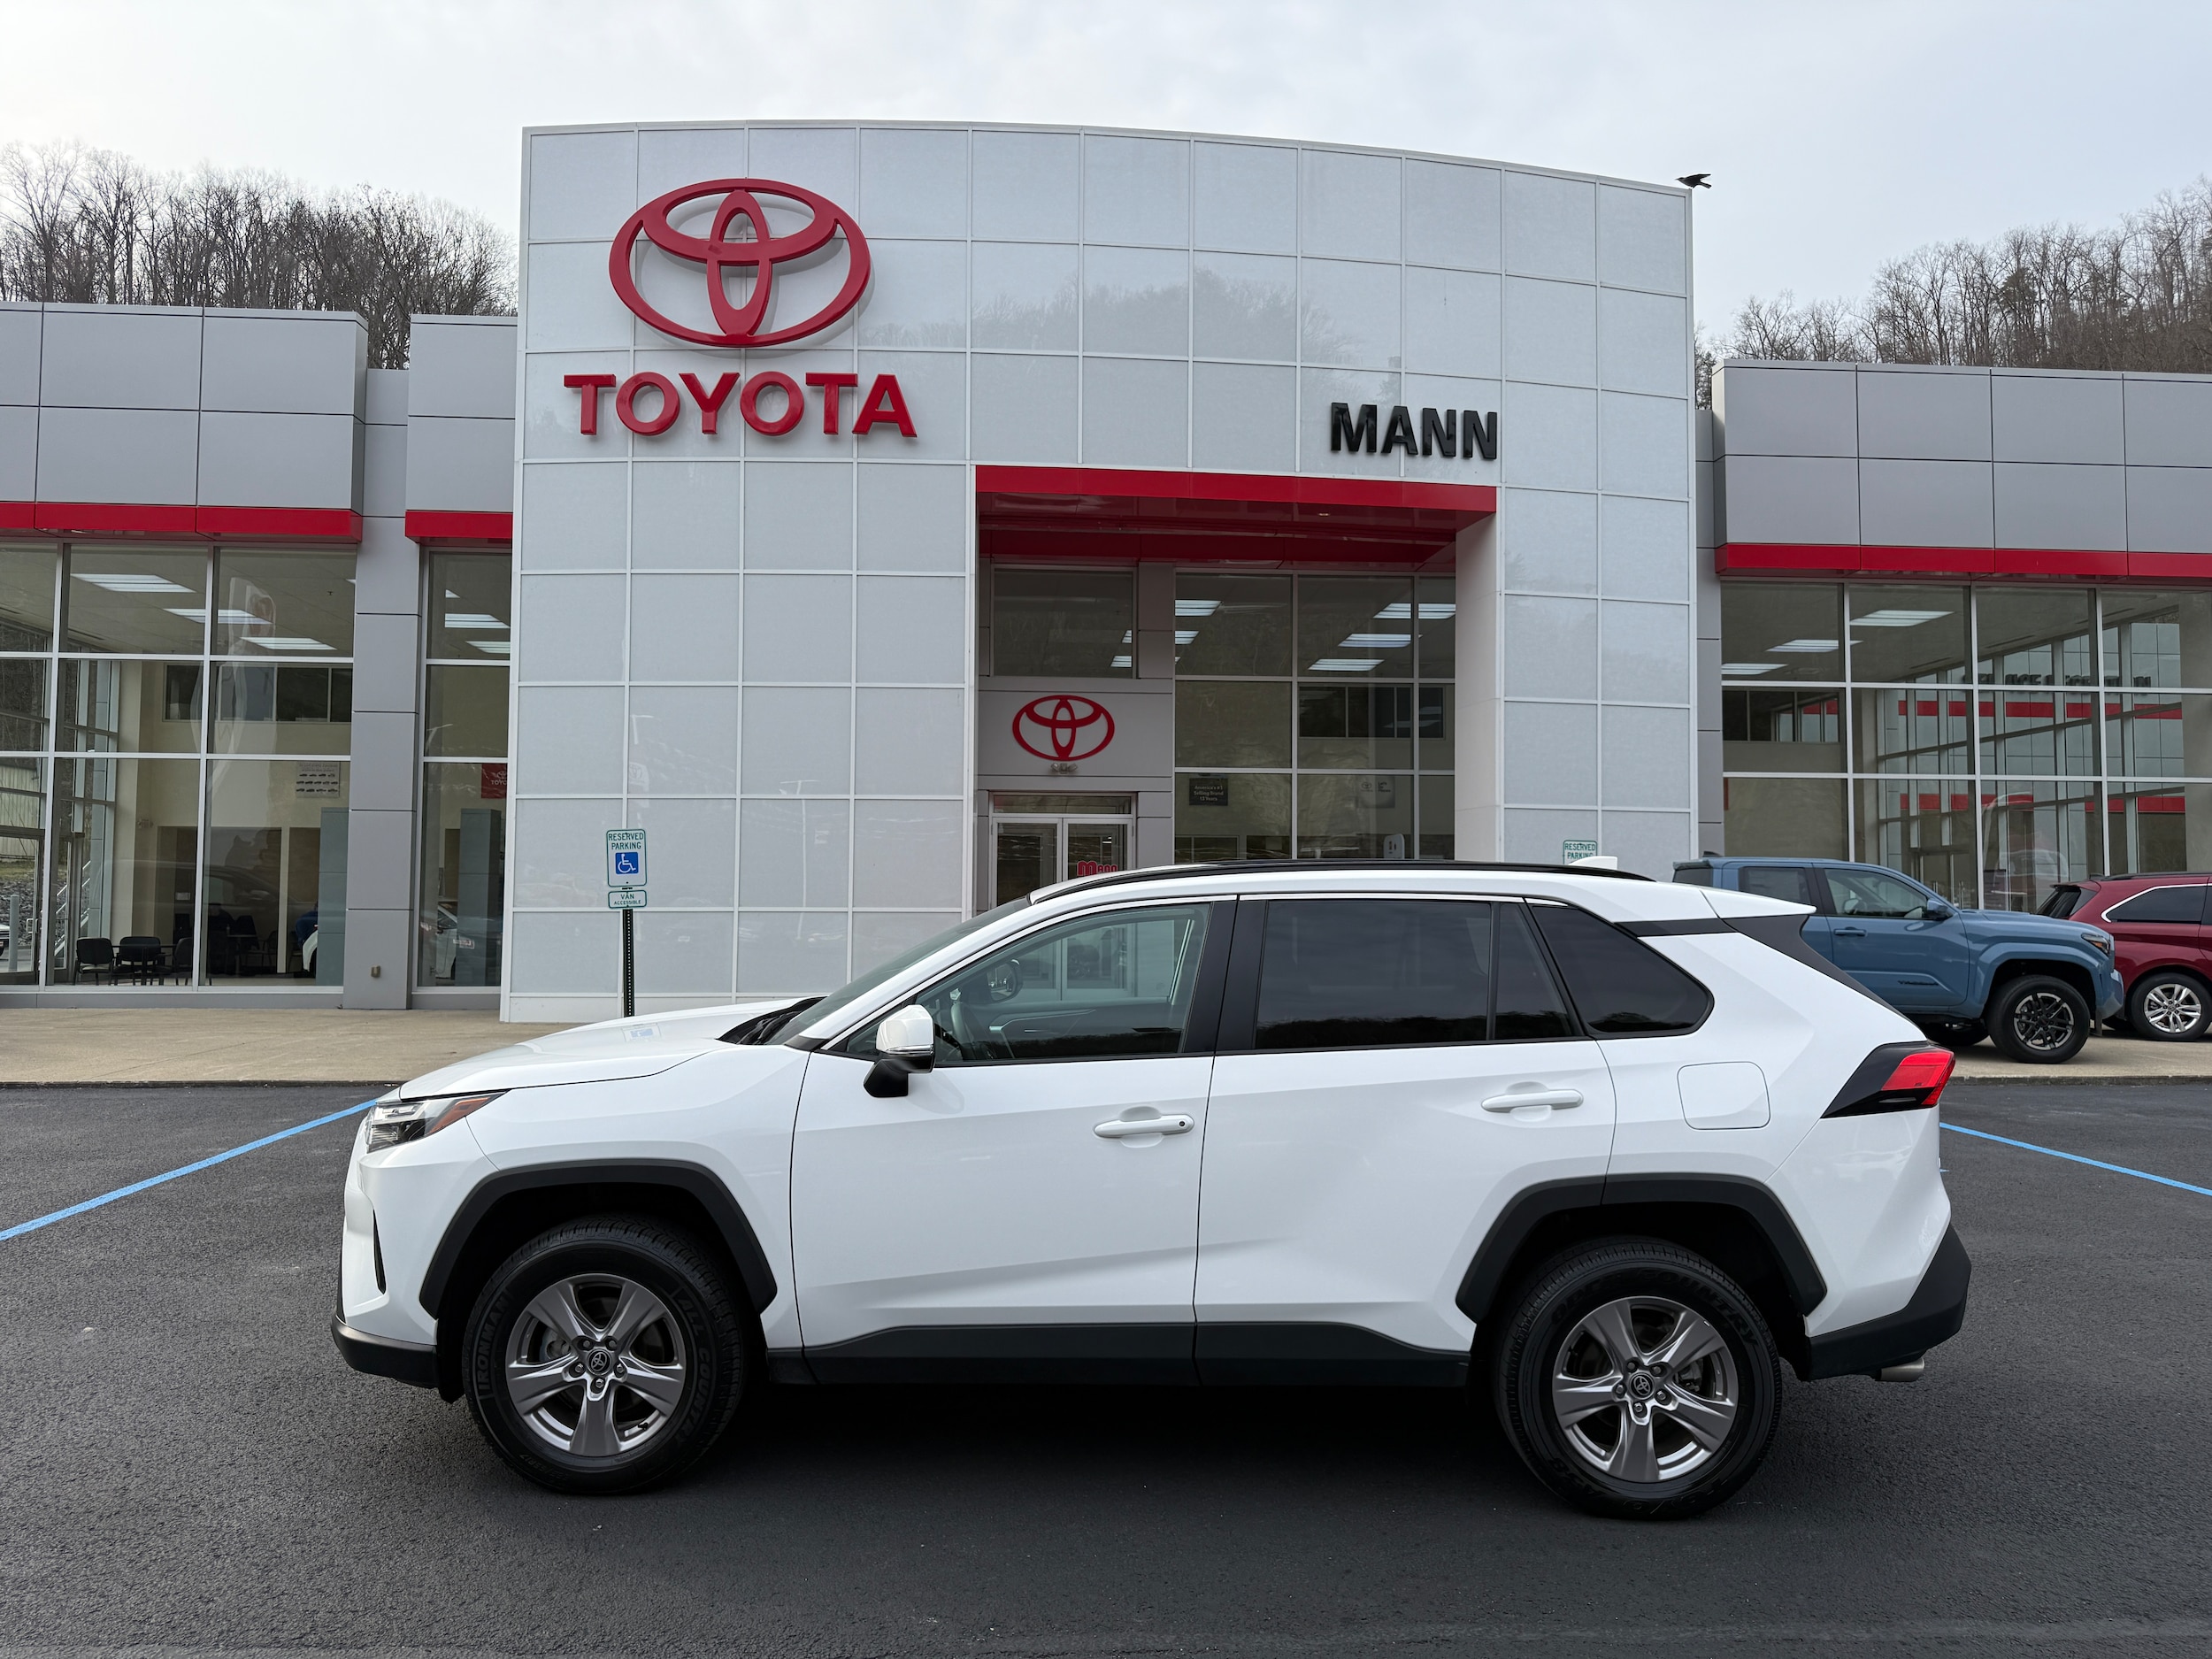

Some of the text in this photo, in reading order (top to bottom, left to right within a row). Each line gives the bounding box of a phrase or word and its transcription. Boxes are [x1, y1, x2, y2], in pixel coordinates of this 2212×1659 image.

[564, 371, 918, 438] TOYOTA
[1331, 402, 1498, 459] MANN
[478, 1291, 511, 1389] IRONMAN
[676, 1296, 706, 1337] ALL
